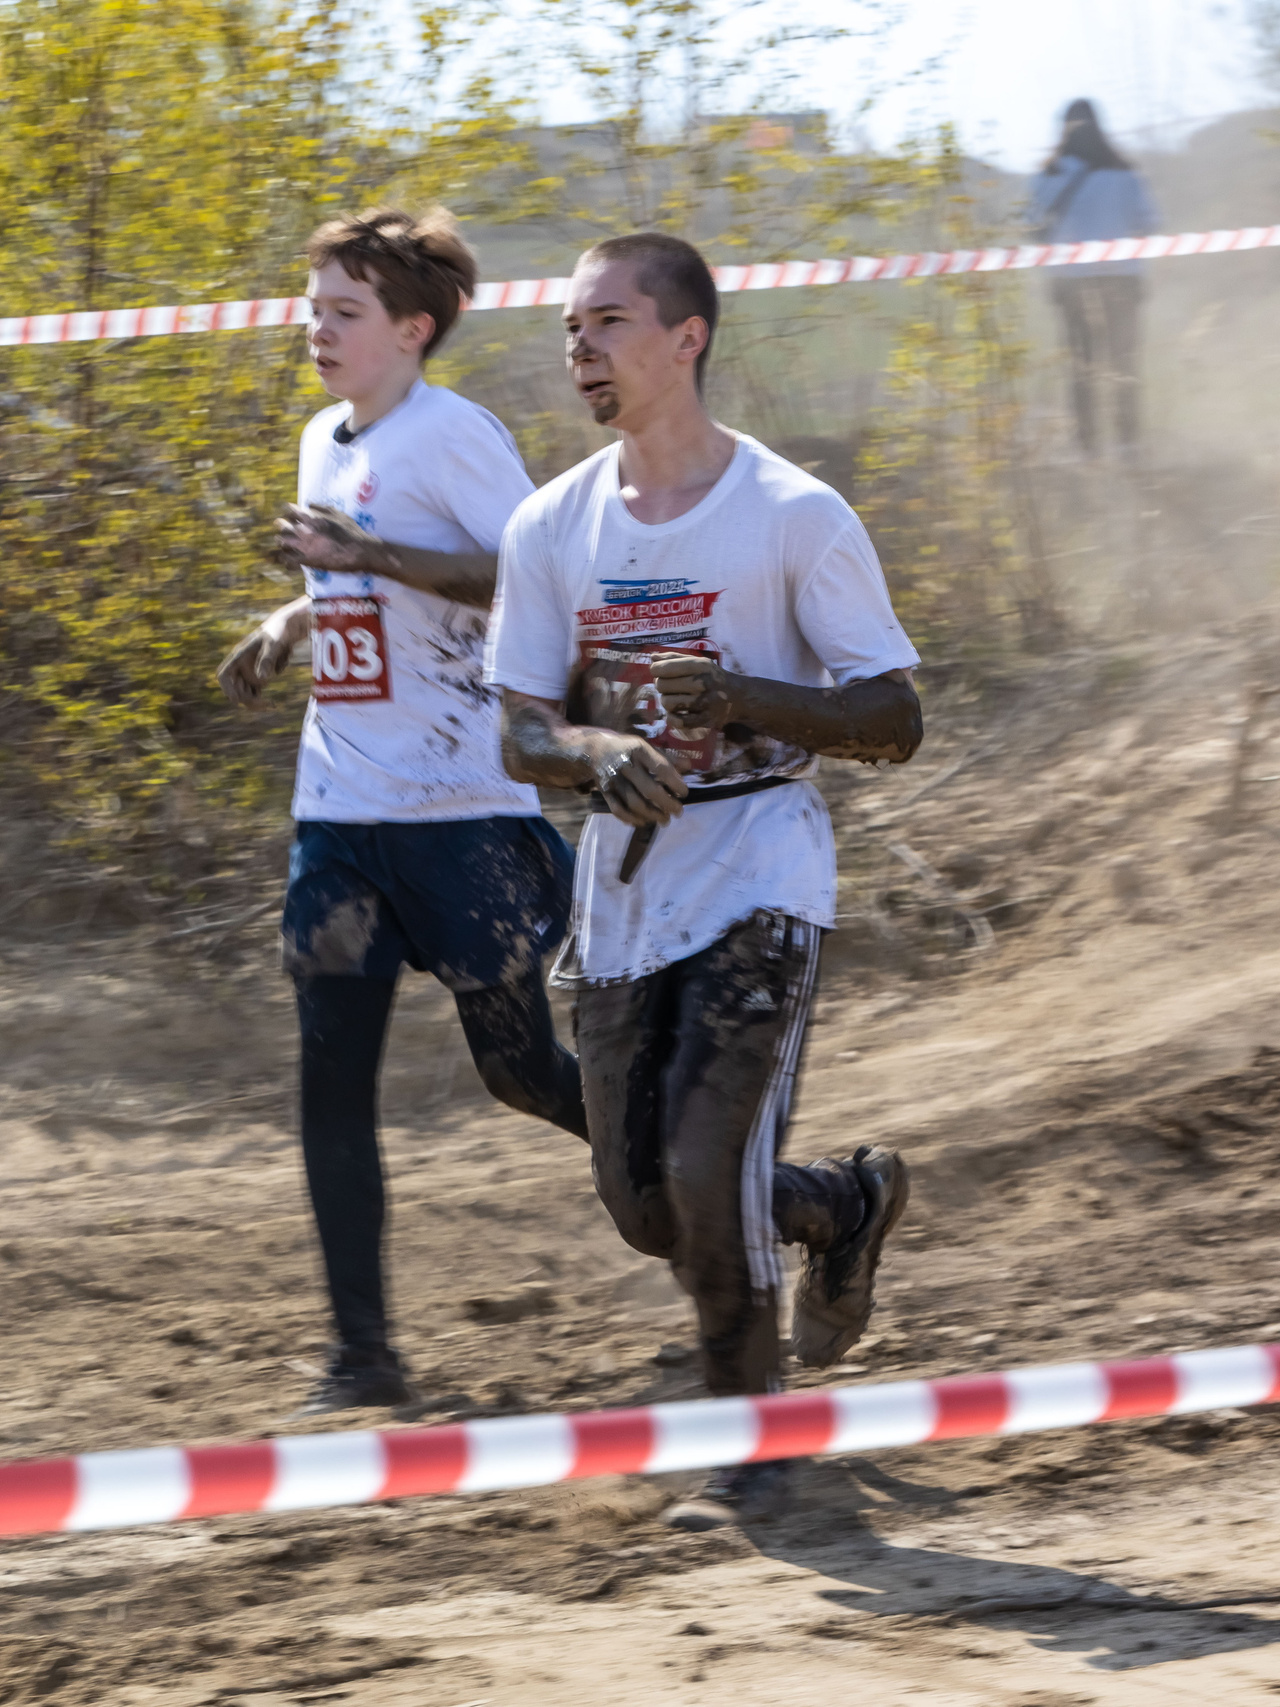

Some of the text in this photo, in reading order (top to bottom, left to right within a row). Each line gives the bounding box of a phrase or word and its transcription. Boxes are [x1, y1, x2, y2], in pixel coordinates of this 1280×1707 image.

[646, 579, 686, 597] 2021
[582, 596, 705, 623] КУБОК РОССИИ
